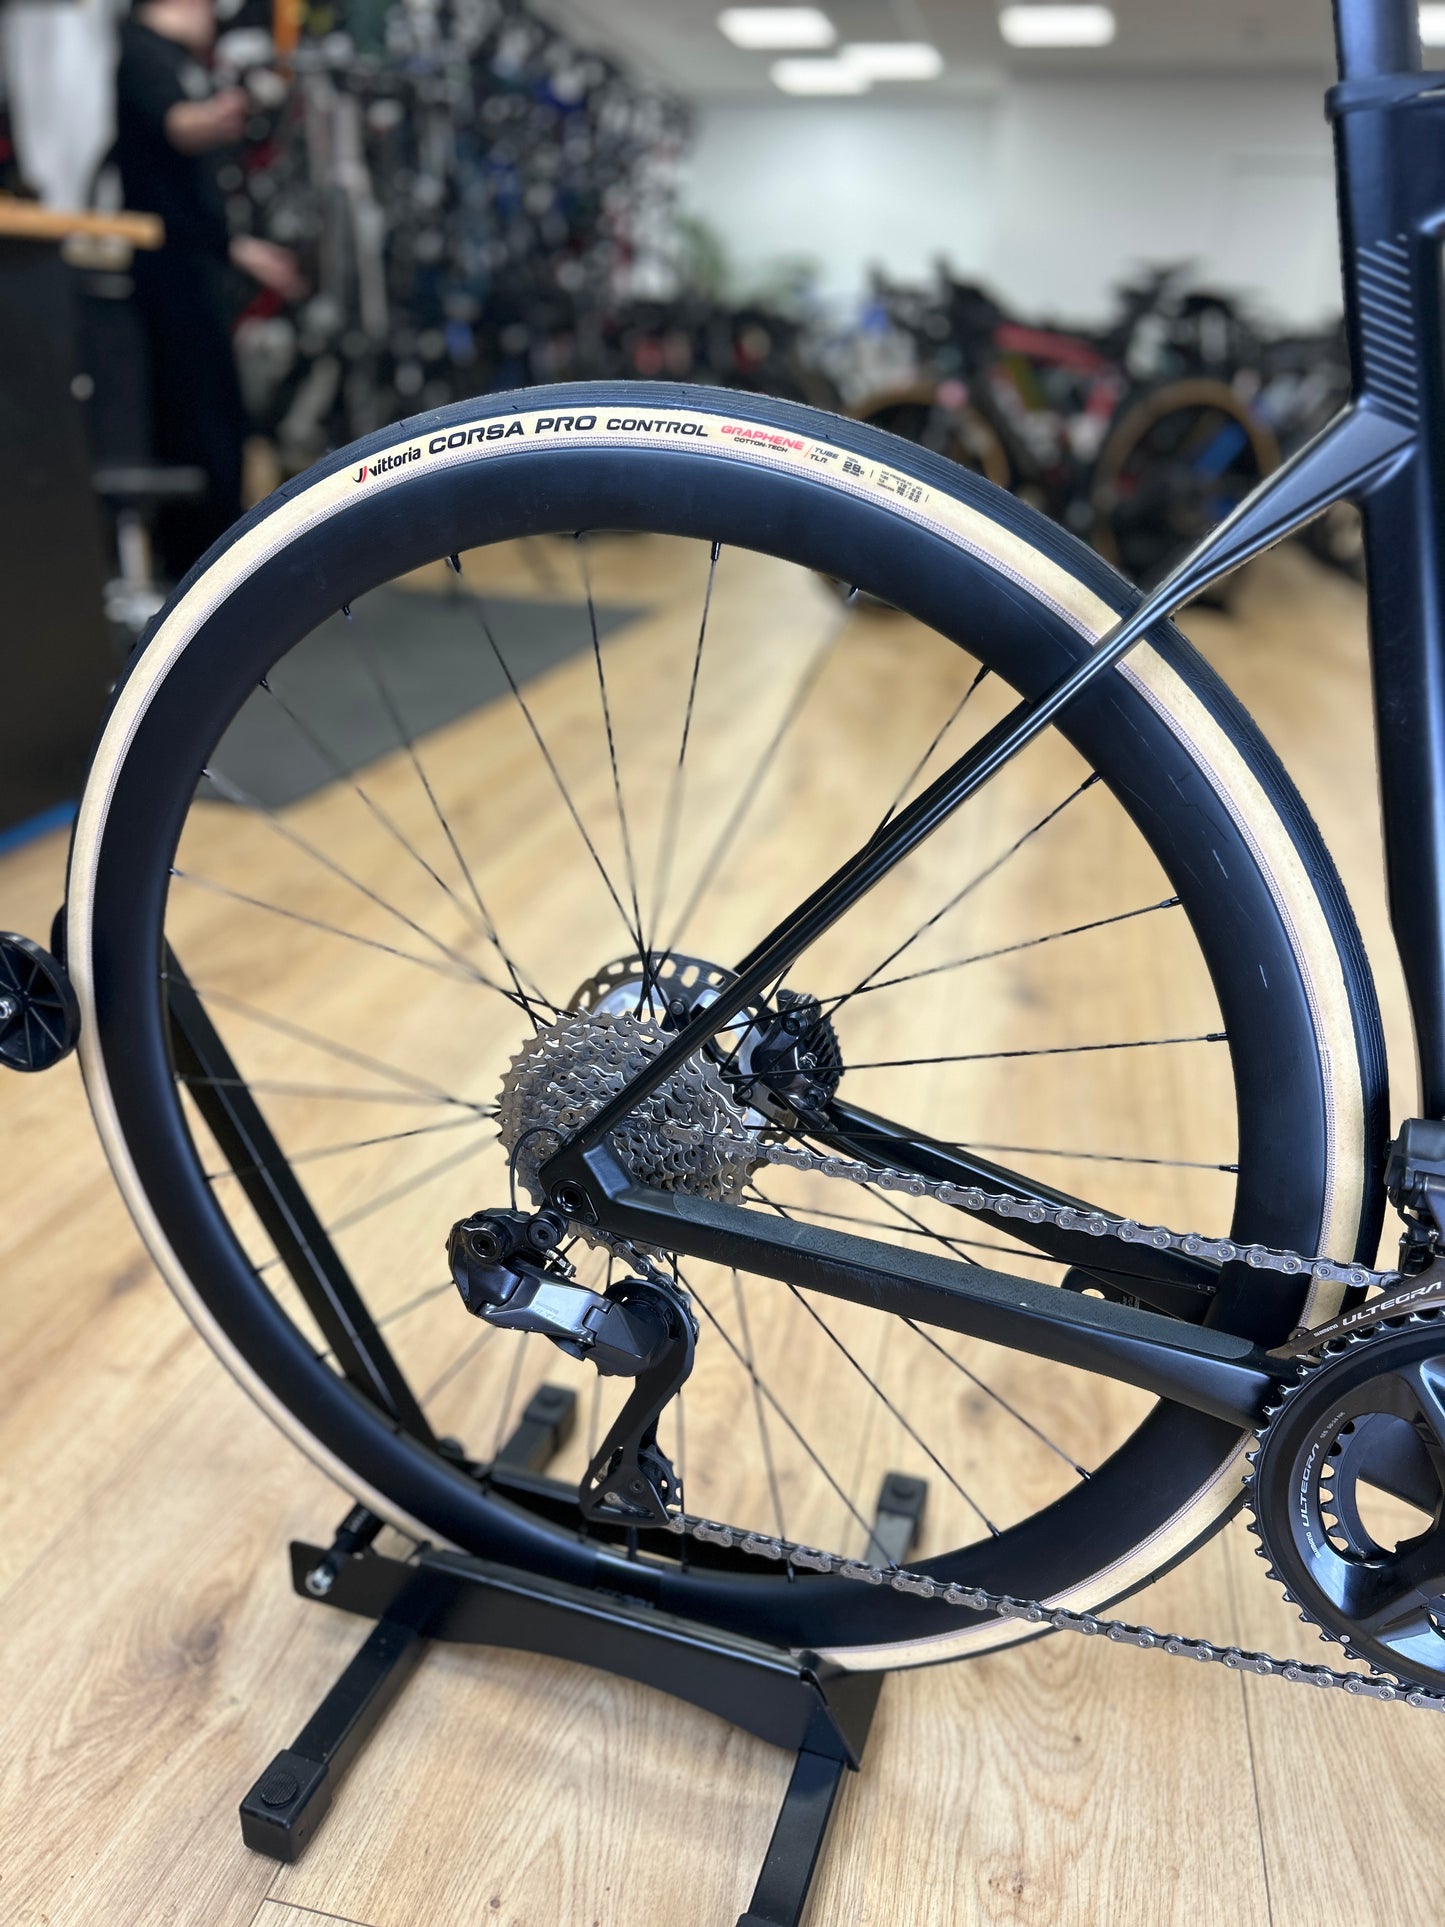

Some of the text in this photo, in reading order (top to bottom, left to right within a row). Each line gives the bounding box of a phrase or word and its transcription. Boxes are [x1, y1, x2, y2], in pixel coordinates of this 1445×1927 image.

[369, 415, 709, 476] vittoria CORSA PRO CONTROL
[721, 425, 805, 450] GRAPHENE
[815, 447, 839, 459] TUBE
[1342, 1281, 1442, 1326] ULTEGRA
[1300, 1442, 1320, 1528] ULTEGRA
